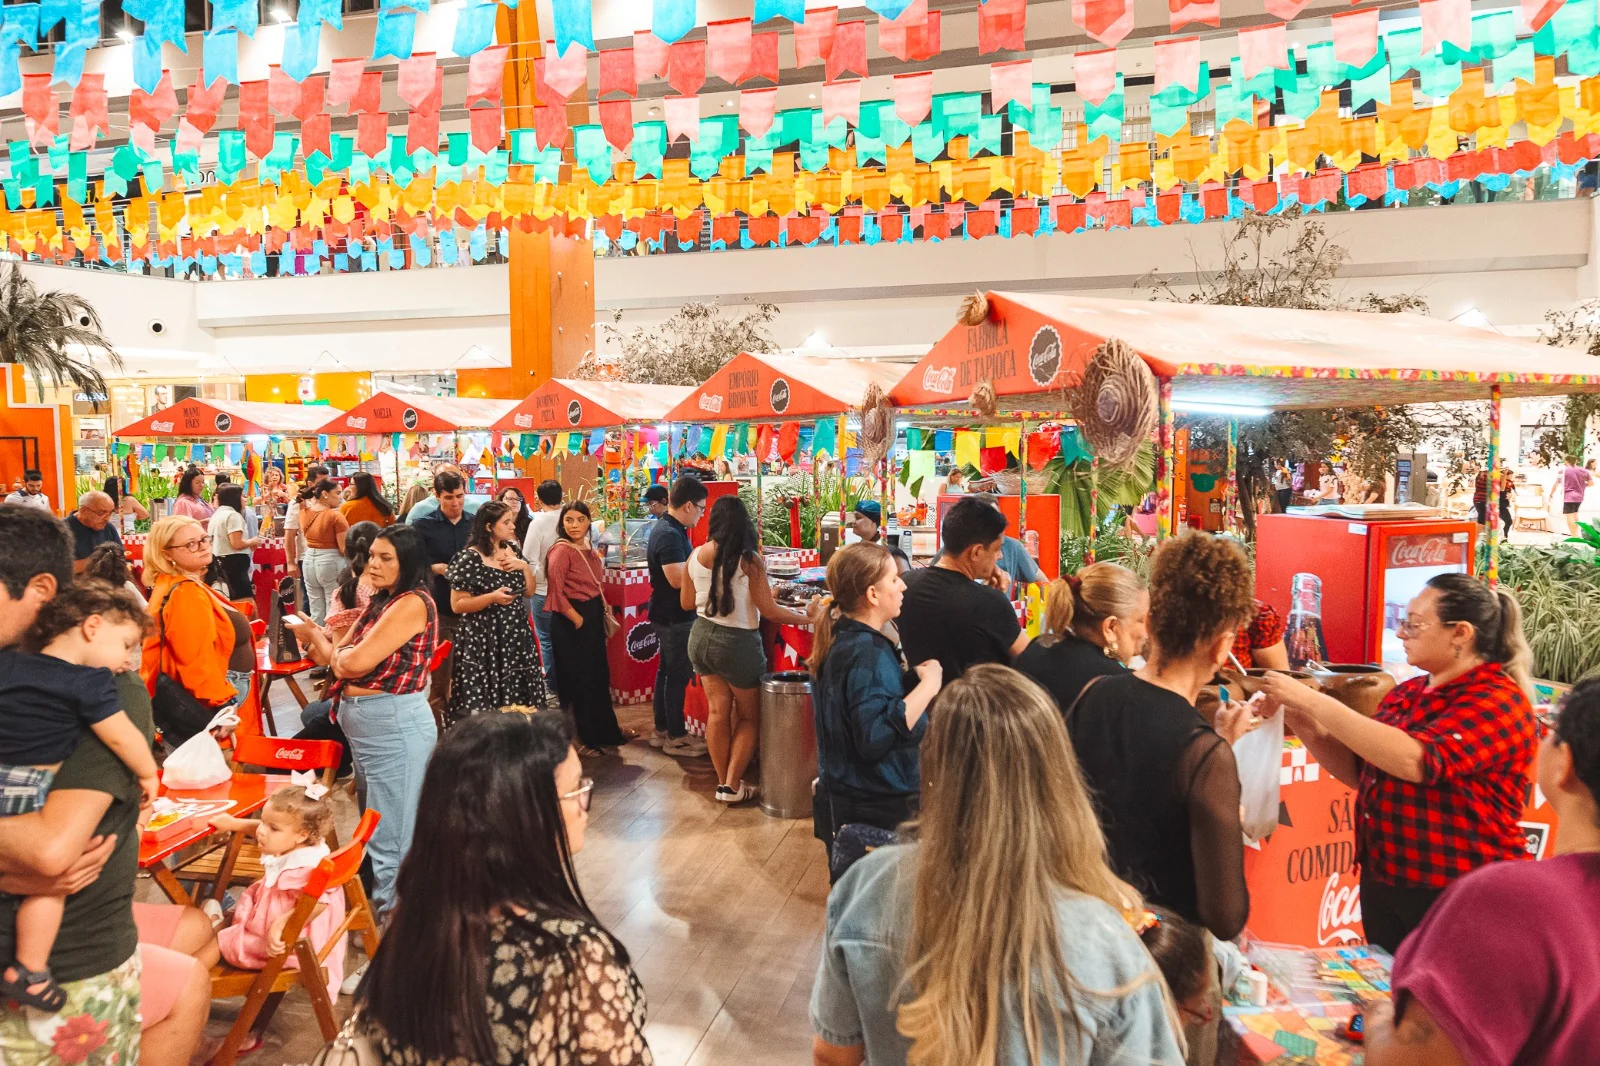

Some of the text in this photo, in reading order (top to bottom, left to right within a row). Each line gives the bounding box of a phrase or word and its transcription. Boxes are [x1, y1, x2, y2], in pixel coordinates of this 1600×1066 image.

[960, 349, 1016, 387] DE TAPIOCA
[1032, 341, 1057, 370] Coca-Cola
[922, 364, 957, 394] Coca-Cola
[1391, 537, 1448, 565] Coca-Cola
[631, 632, 657, 652] Coca-Cola
[1328, 792, 1354, 834] SÃ
[1287, 841, 1354, 884] COMID
